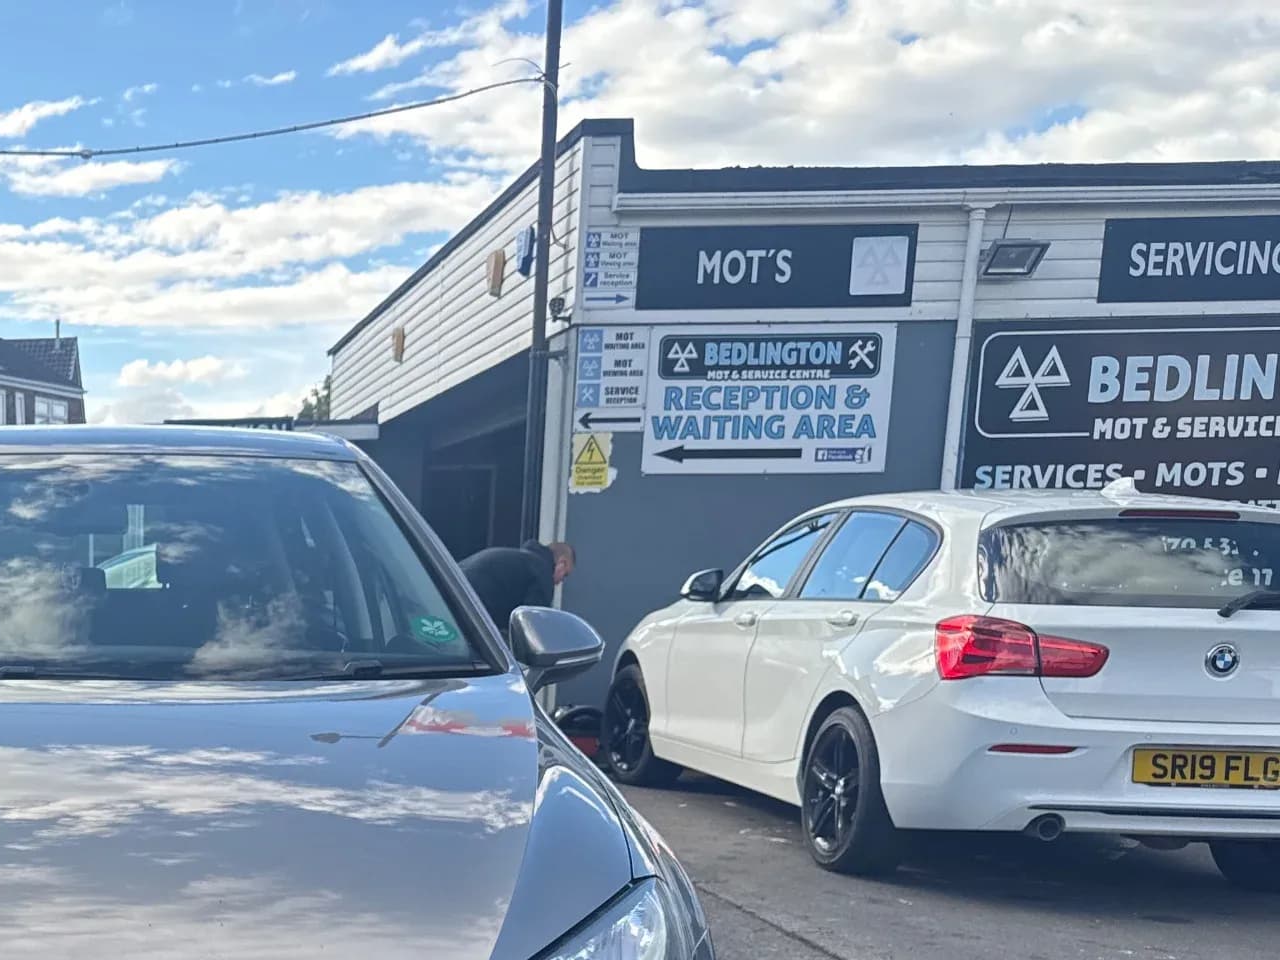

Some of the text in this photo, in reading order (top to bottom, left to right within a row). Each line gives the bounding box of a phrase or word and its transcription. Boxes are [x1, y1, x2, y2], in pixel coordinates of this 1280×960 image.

[696, 249, 793, 285] MOT'S
[615, 332, 634, 341] MOT
[614, 359, 632, 368] MOT
[703, 340, 842, 366] BEDLINGTON
[707, 370, 730, 380] MOT
[741, 369, 788, 379] SERVICE
[789, 369, 831, 379] CENTRE
[1088, 354, 1278, 403] BEDLIN
[604, 386, 639, 395] SERVICE
[663, 384, 870, 411] RECEPTION &
[651, 414, 877, 440] WAITING AREA
[1093, 418, 1148, 440] MOT
[1152, 417, 1171, 438] &
[974, 463, 1124, 490] SERVICES
[1155, 461, 1245, 487] MOTS
[1151, 753, 1280, 782] SR19 FLG
